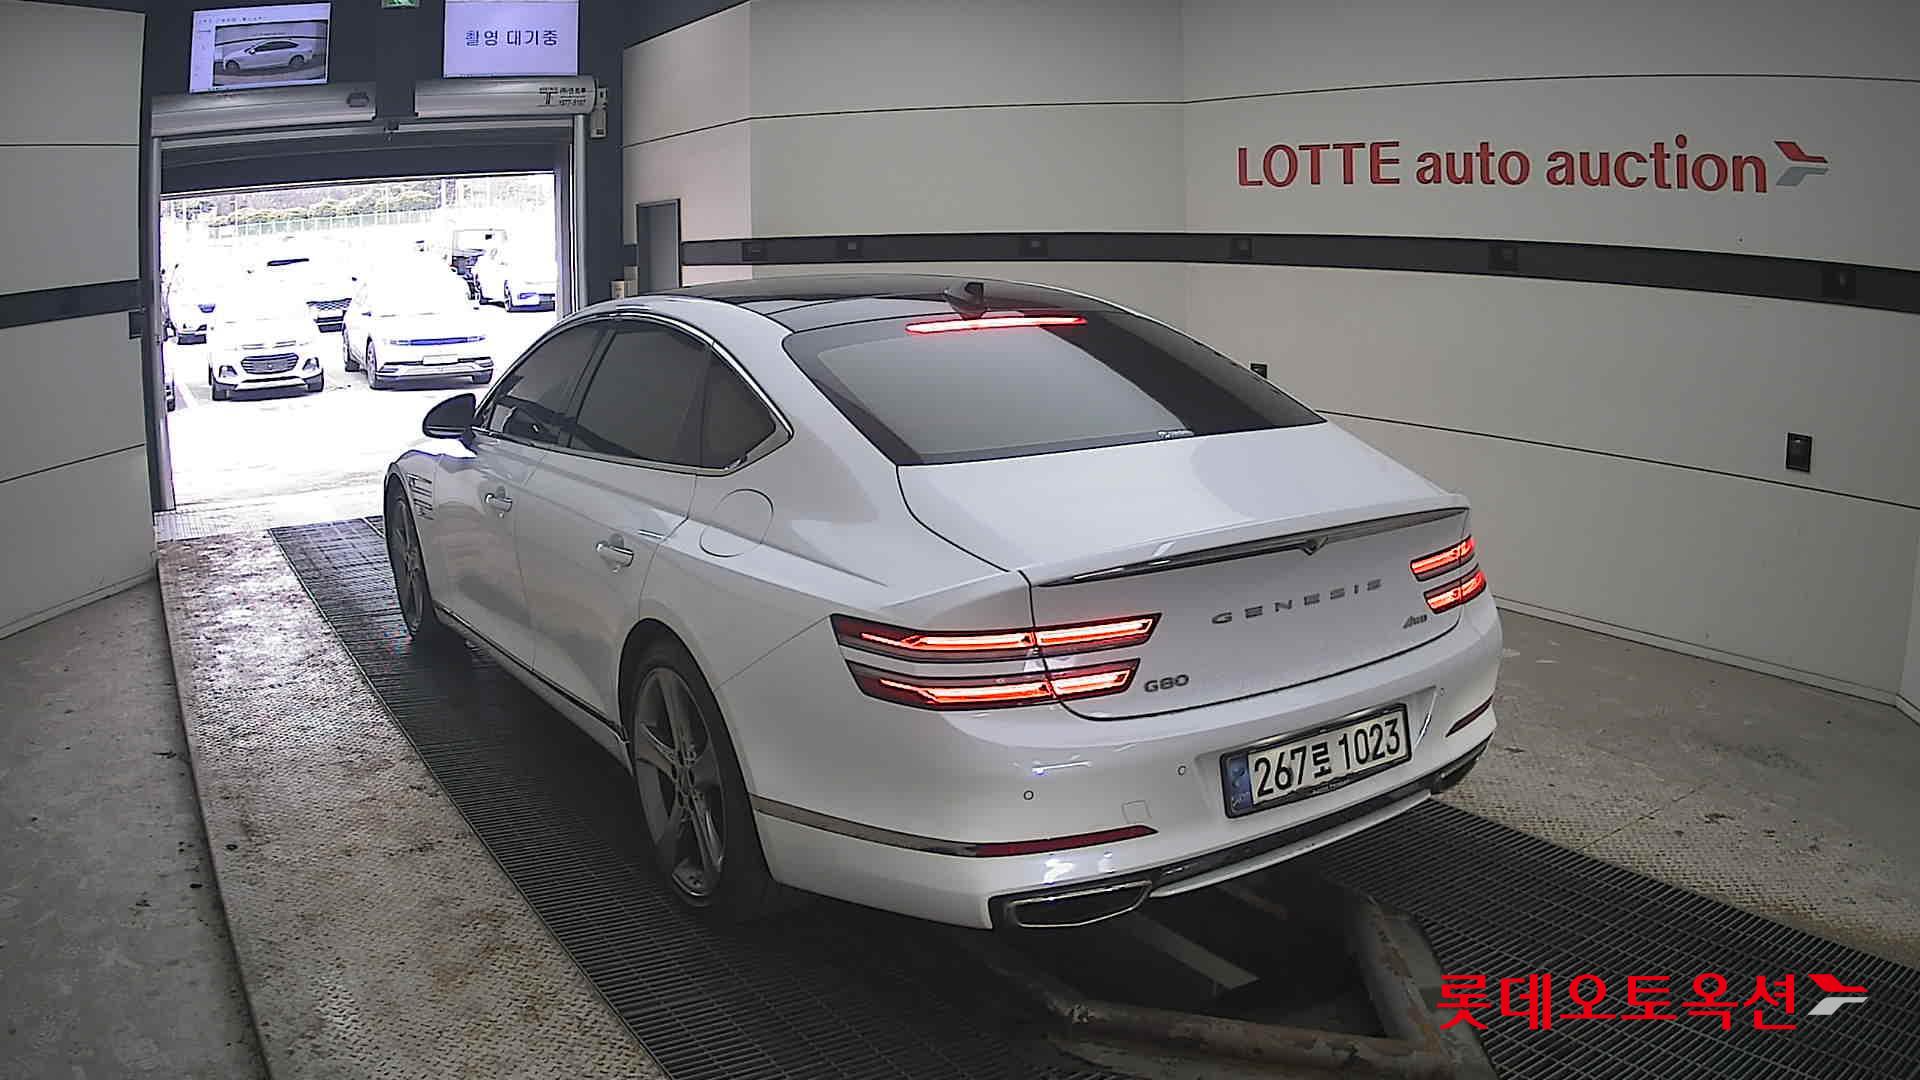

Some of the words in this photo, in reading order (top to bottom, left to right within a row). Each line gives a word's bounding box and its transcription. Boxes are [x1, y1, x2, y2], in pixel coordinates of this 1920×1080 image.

[506, 30, 558, 46] 대기중
[1237, 142, 1400, 188] LOTTE
[1416, 142, 1531, 186] auto
[1546, 135, 1768, 193] auction
[1211, 578, 1382, 625] GENESIS
[1144, 673, 1190, 693] G80
[1337, 717, 1401, 771] 1023
